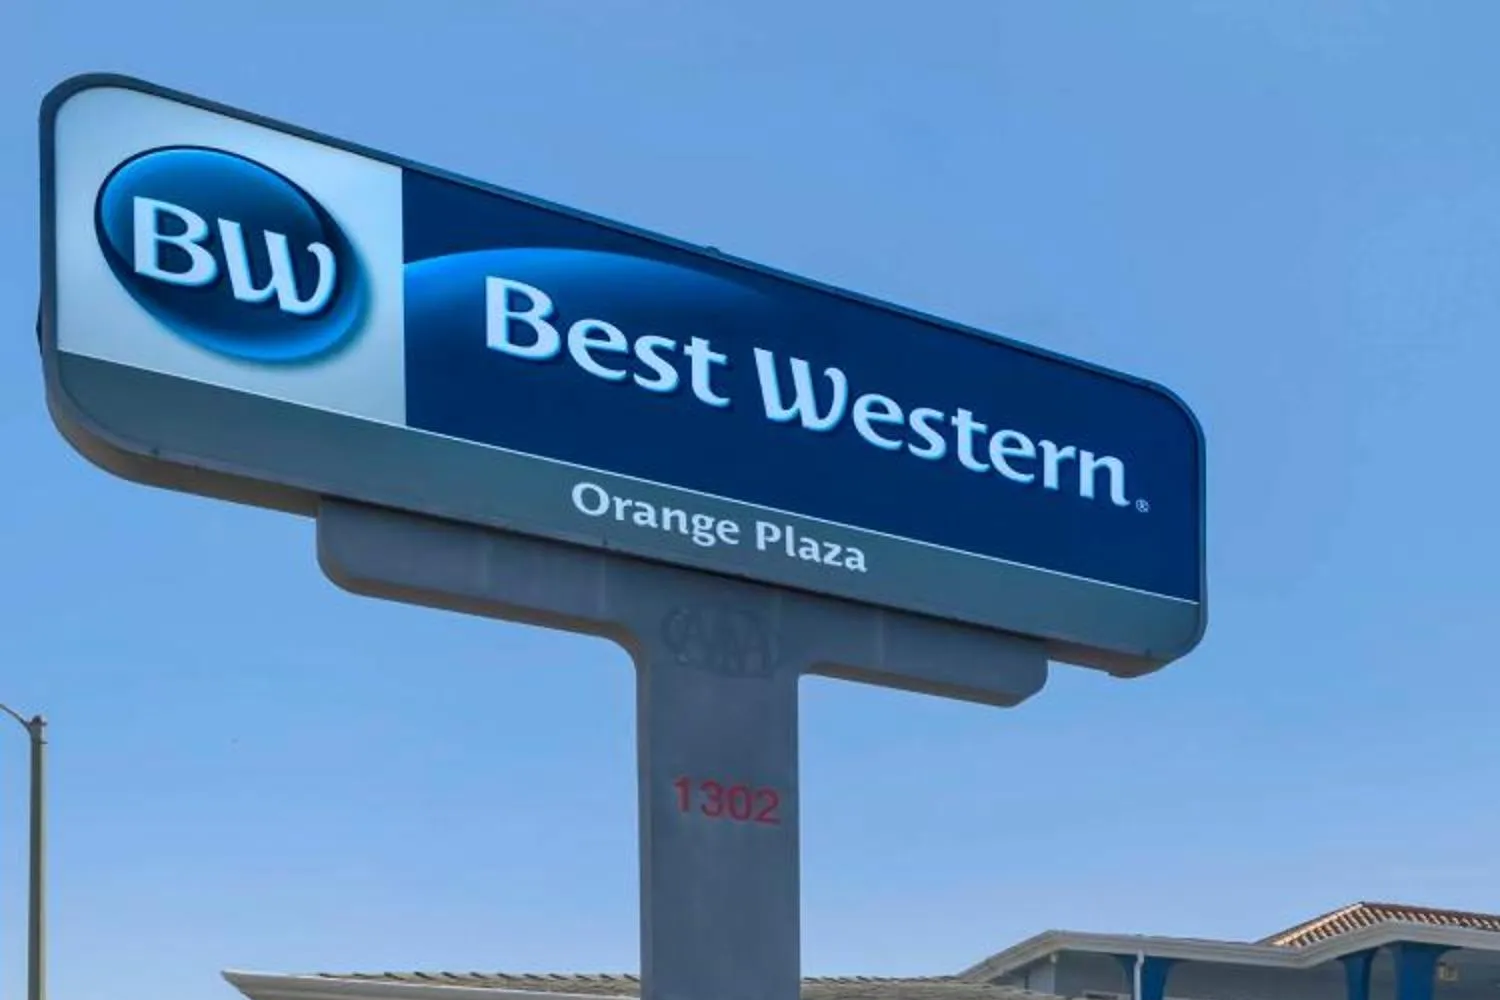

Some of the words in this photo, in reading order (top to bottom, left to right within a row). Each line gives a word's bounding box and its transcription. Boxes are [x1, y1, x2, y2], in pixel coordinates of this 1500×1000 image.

[133, 195, 337, 314] BW
[485, 275, 731, 408] Best
[753, 347, 1131, 506] Western
[571, 482, 741, 548] Orange
[755, 520, 868, 573] Plaza
[673, 775, 782, 826] 1302
